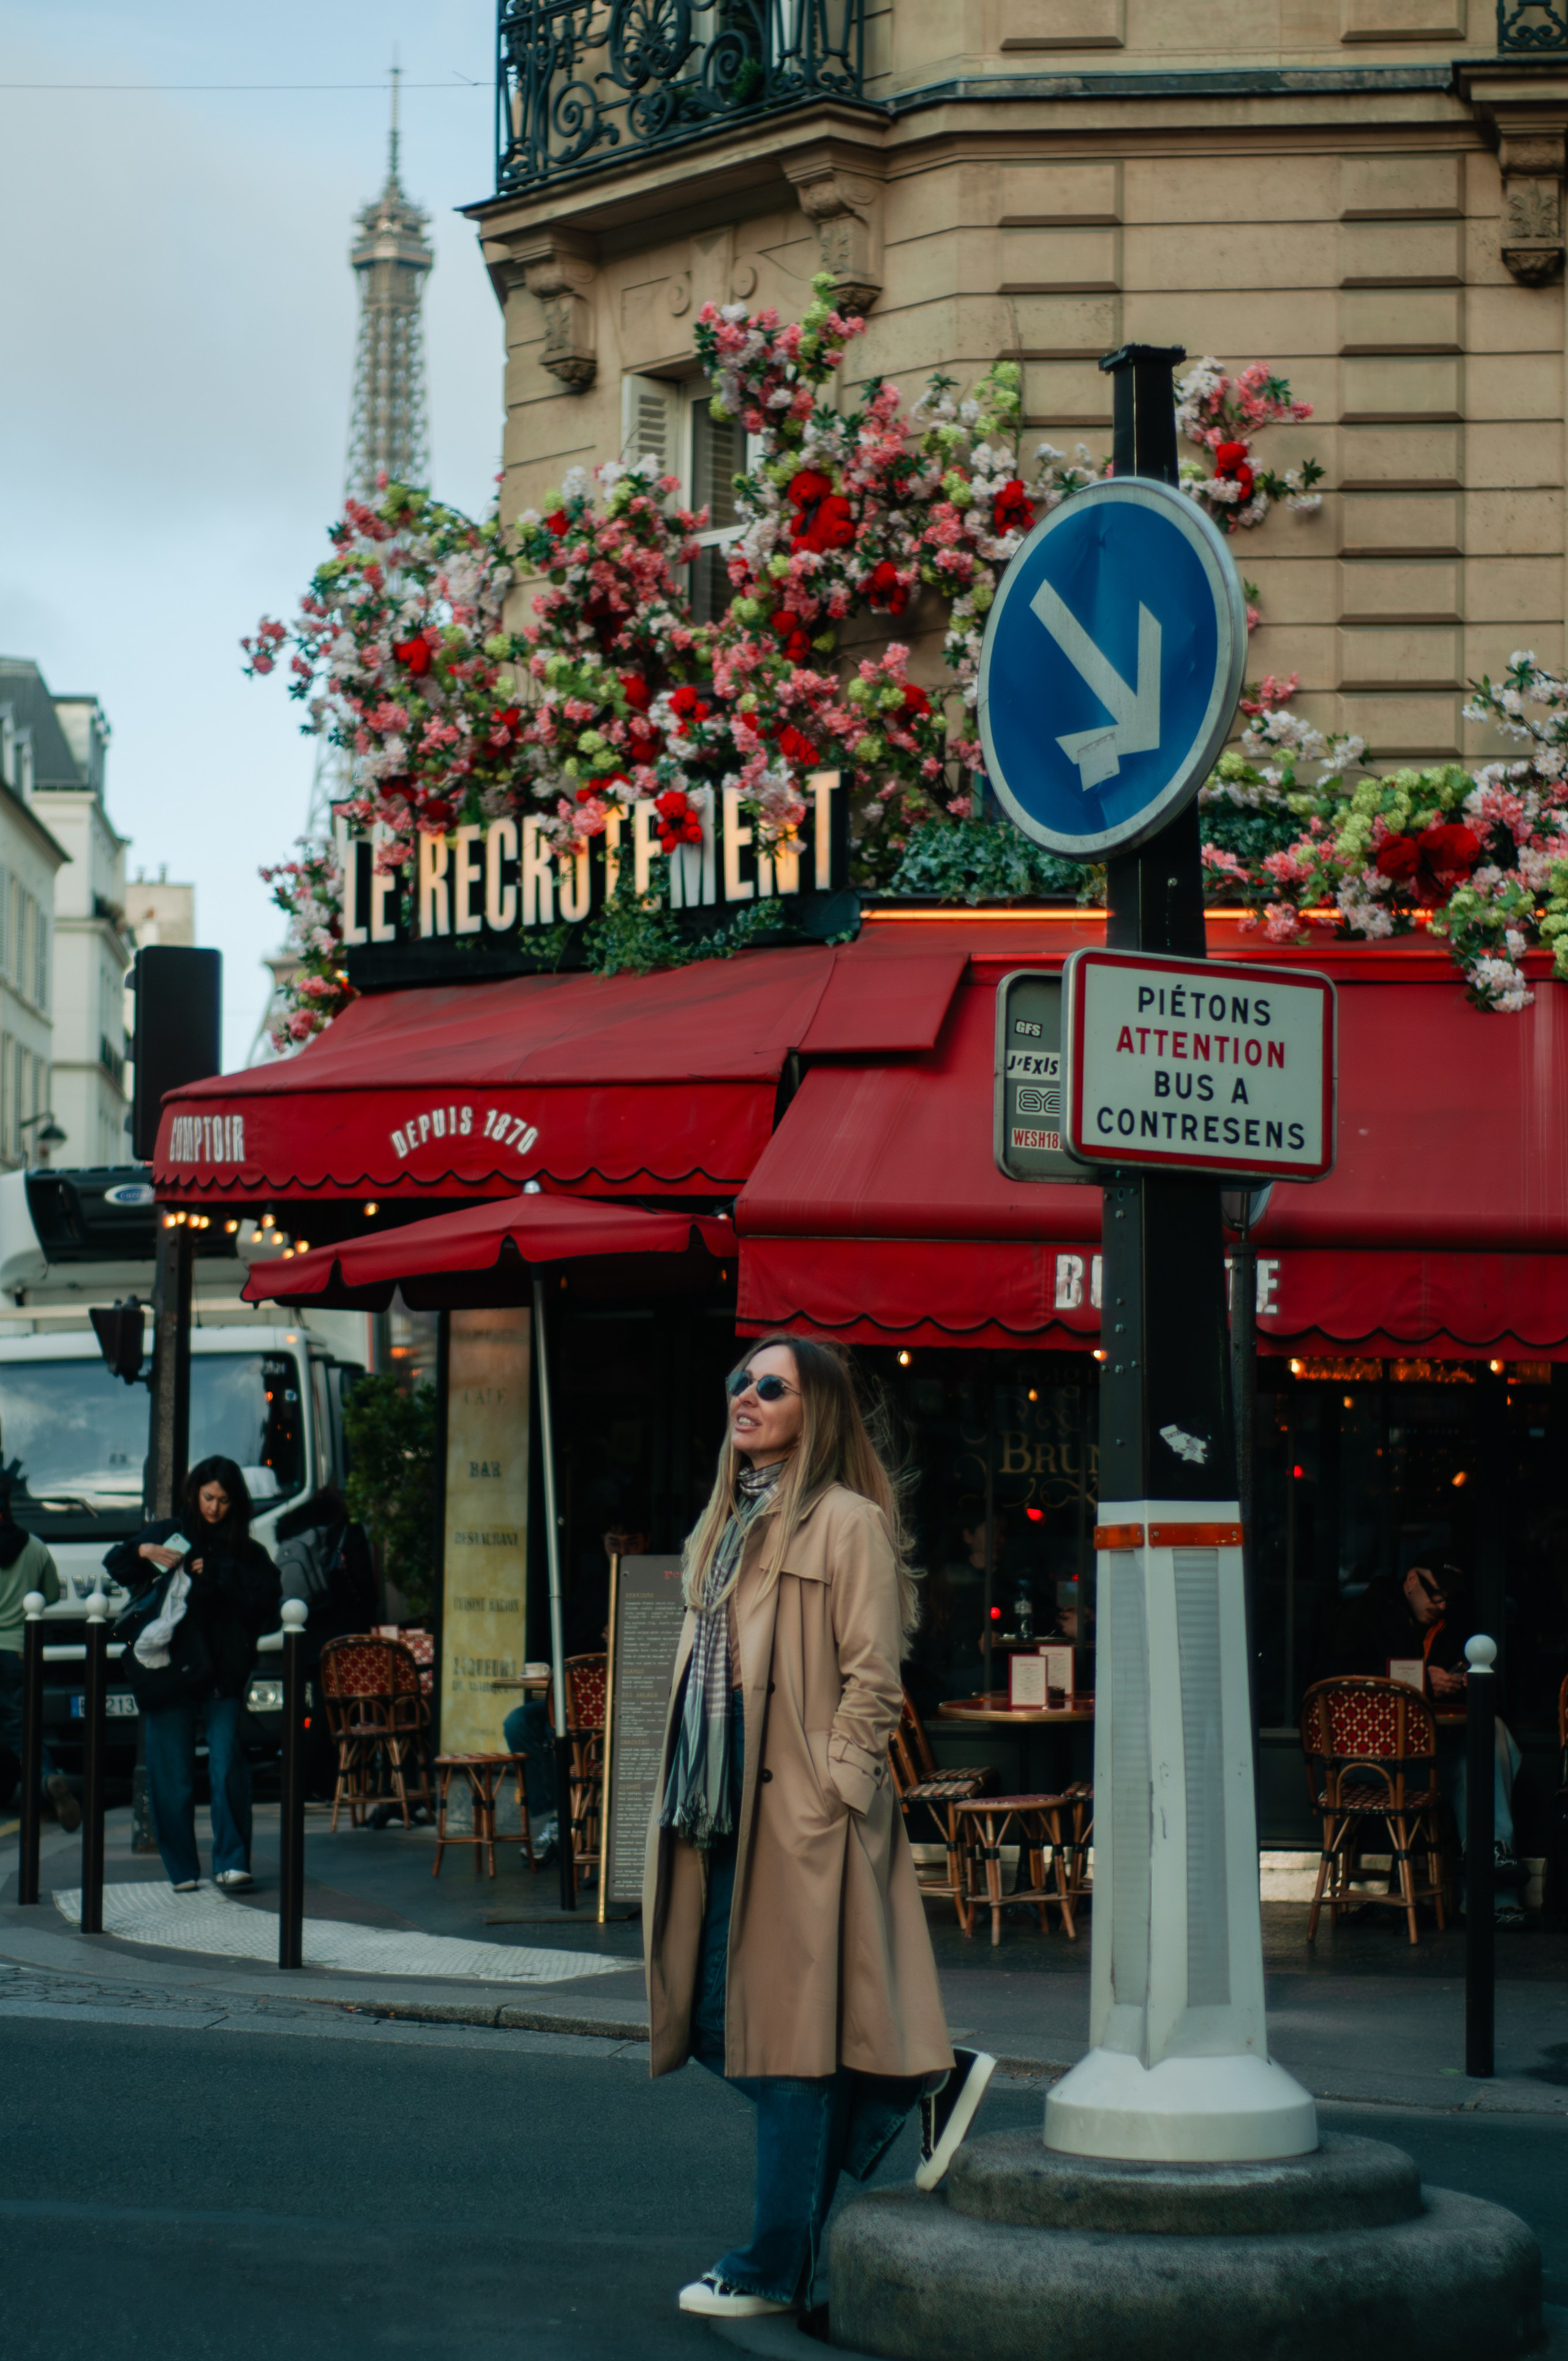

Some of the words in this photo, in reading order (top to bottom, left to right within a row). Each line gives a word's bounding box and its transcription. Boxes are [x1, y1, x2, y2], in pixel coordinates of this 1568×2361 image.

[343, 837, 397, 945] LE
[1137, 984, 1271, 1026] PIÉTONS
[1015, 1021, 1041, 1037] GFS
[1116, 1025, 1285, 1069] ATTENTION
[1154, 1071, 1214, 1101] BUS
[1231, 1077, 1250, 1105] A
[169, 1115, 245, 1162] COMPTOIR
[390, 1105, 474, 1159] DEPUIS
[483, 1109, 539, 1155] 1870
[1013, 1129, 1063, 1150] WESH18
[1097, 1106, 1305, 1150] CONTRESENS
[469, 1462, 501, 1478] BAR
[454, 1532, 519, 1547] RESTAURANT
